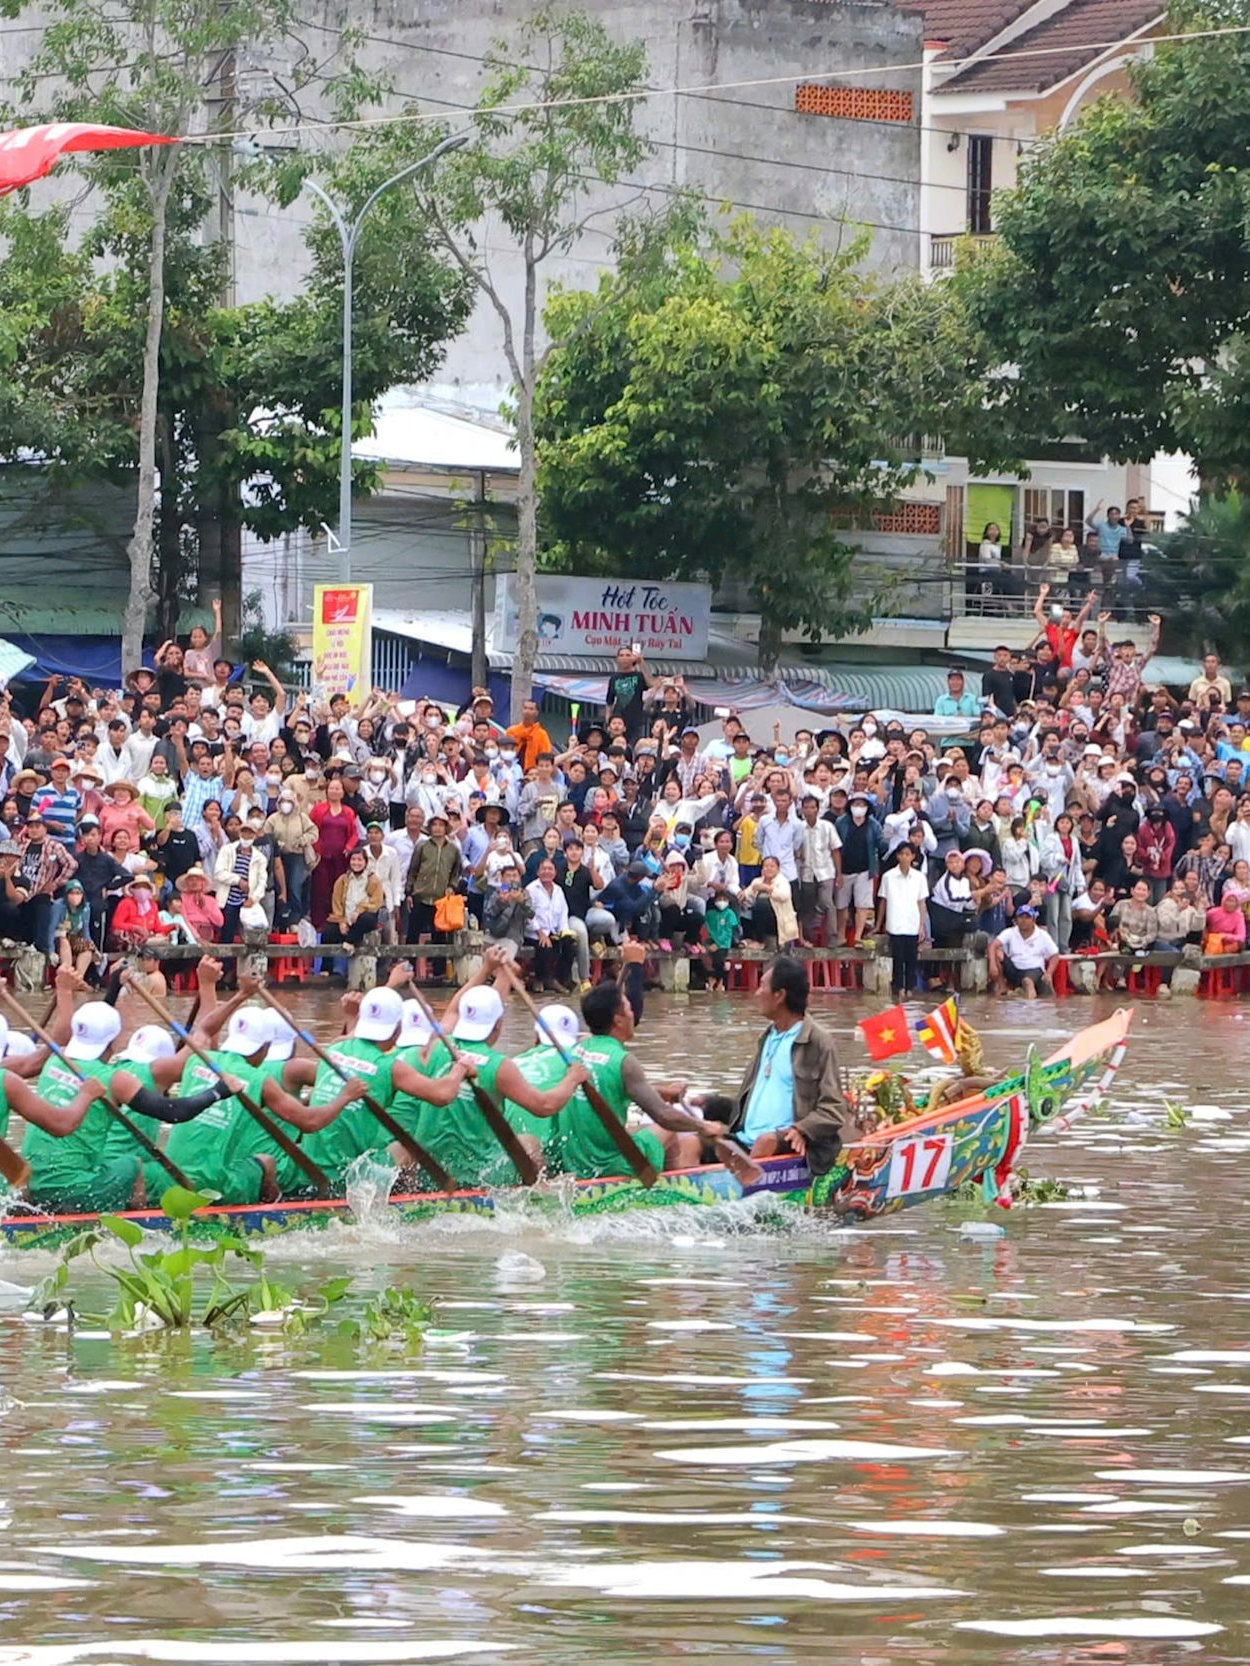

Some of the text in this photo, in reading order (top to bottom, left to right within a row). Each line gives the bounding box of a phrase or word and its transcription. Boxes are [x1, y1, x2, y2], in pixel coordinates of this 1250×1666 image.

[641, 586, 670, 610] Tóc
[570, 606, 694, 635] MINH TUẤN
[901, 1138, 946, 1192] 17
